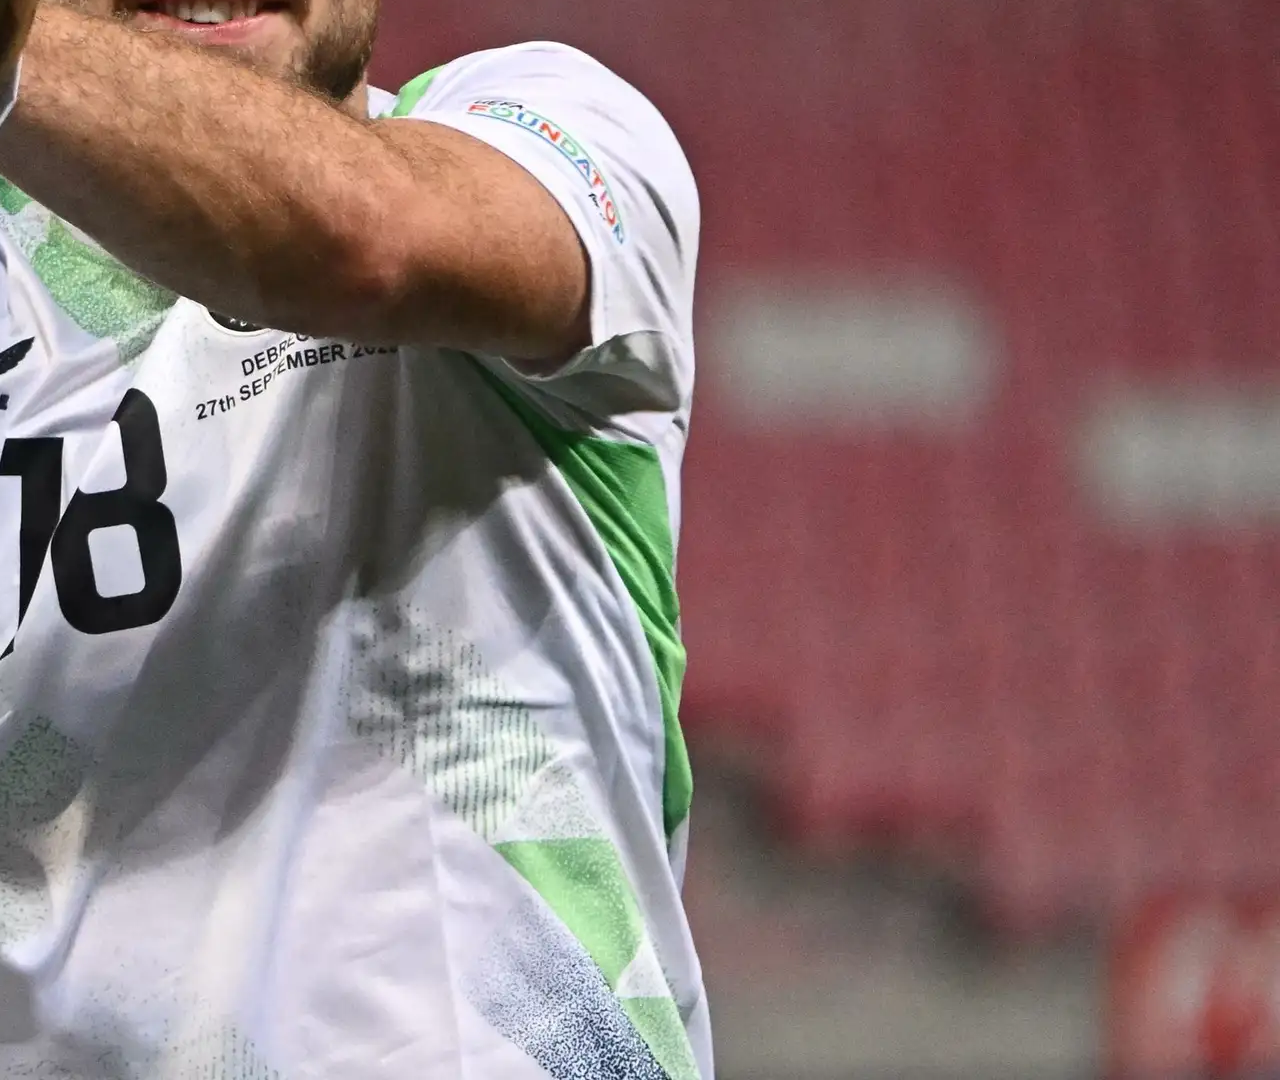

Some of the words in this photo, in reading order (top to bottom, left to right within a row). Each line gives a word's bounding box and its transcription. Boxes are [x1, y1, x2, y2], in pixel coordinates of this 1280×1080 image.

[467, 104, 625, 245] FOUNDATION
[195, 395, 237, 420] 27th
[240, 344, 347, 401] SEPTEMBER
[241, 333, 308, 376] DEBRE
